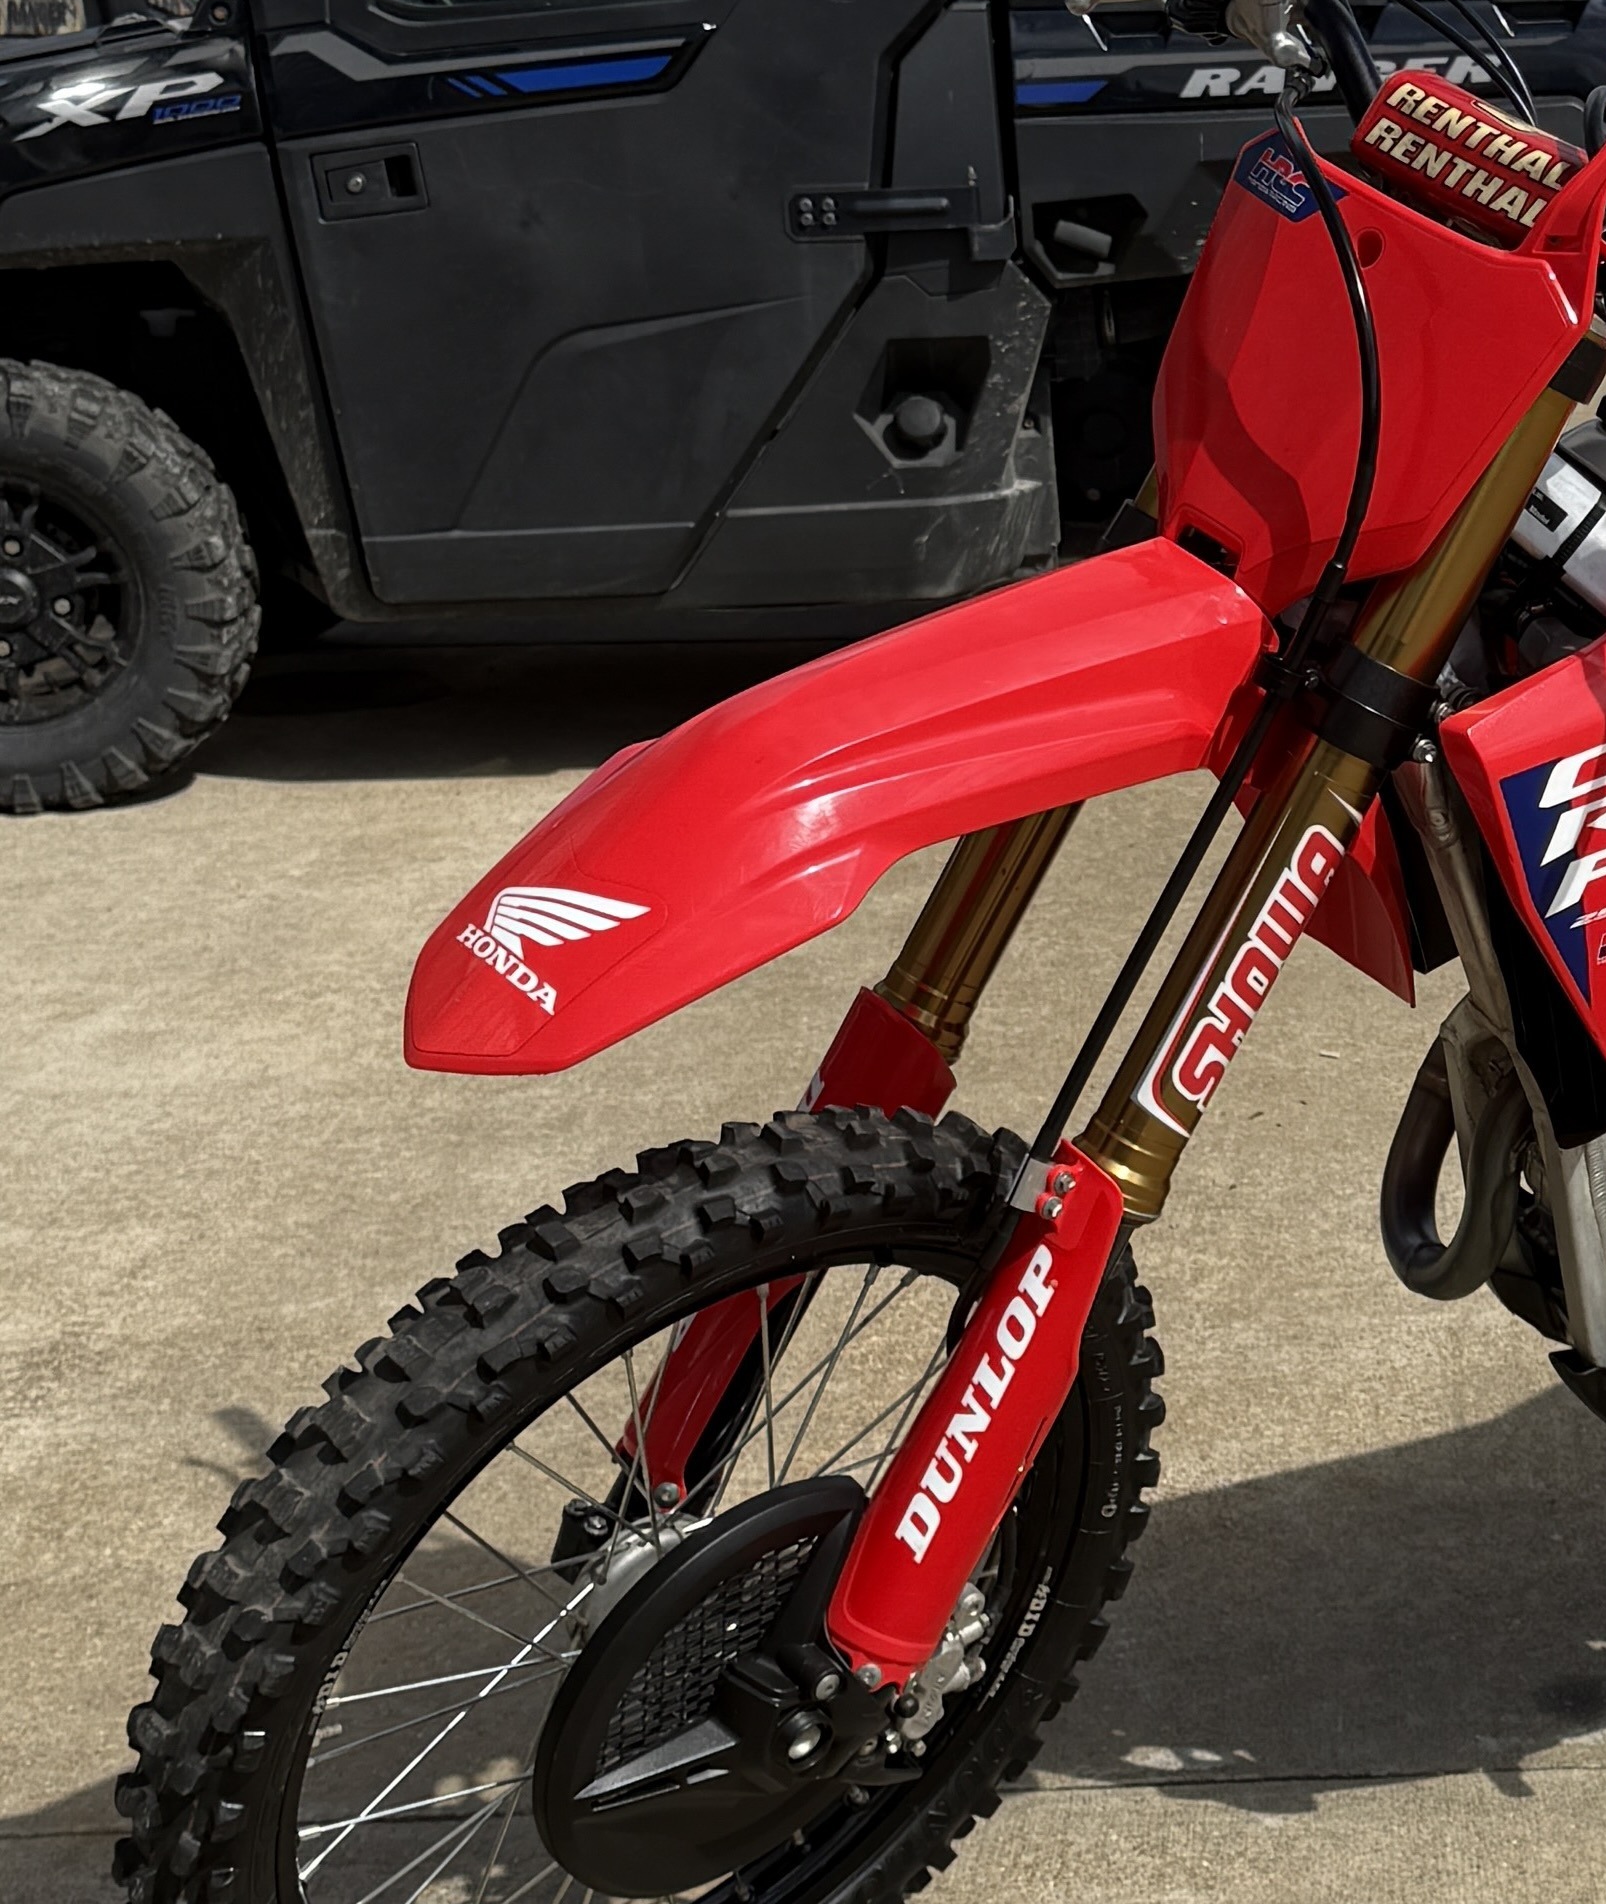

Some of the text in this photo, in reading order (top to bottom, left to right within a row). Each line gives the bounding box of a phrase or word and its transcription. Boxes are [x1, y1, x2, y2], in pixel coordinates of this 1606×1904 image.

[12, 71, 241, 142] XP 1000
[1386, 81, 1573, 192] RENTHAL
[1364, 116, 1548, 228] RENTHAL
[454, 922, 558, 1017] HONDA
[1173, 822, 1346, 1110] SHOWA
[893, 1242, 1056, 1565] DUNLOP
